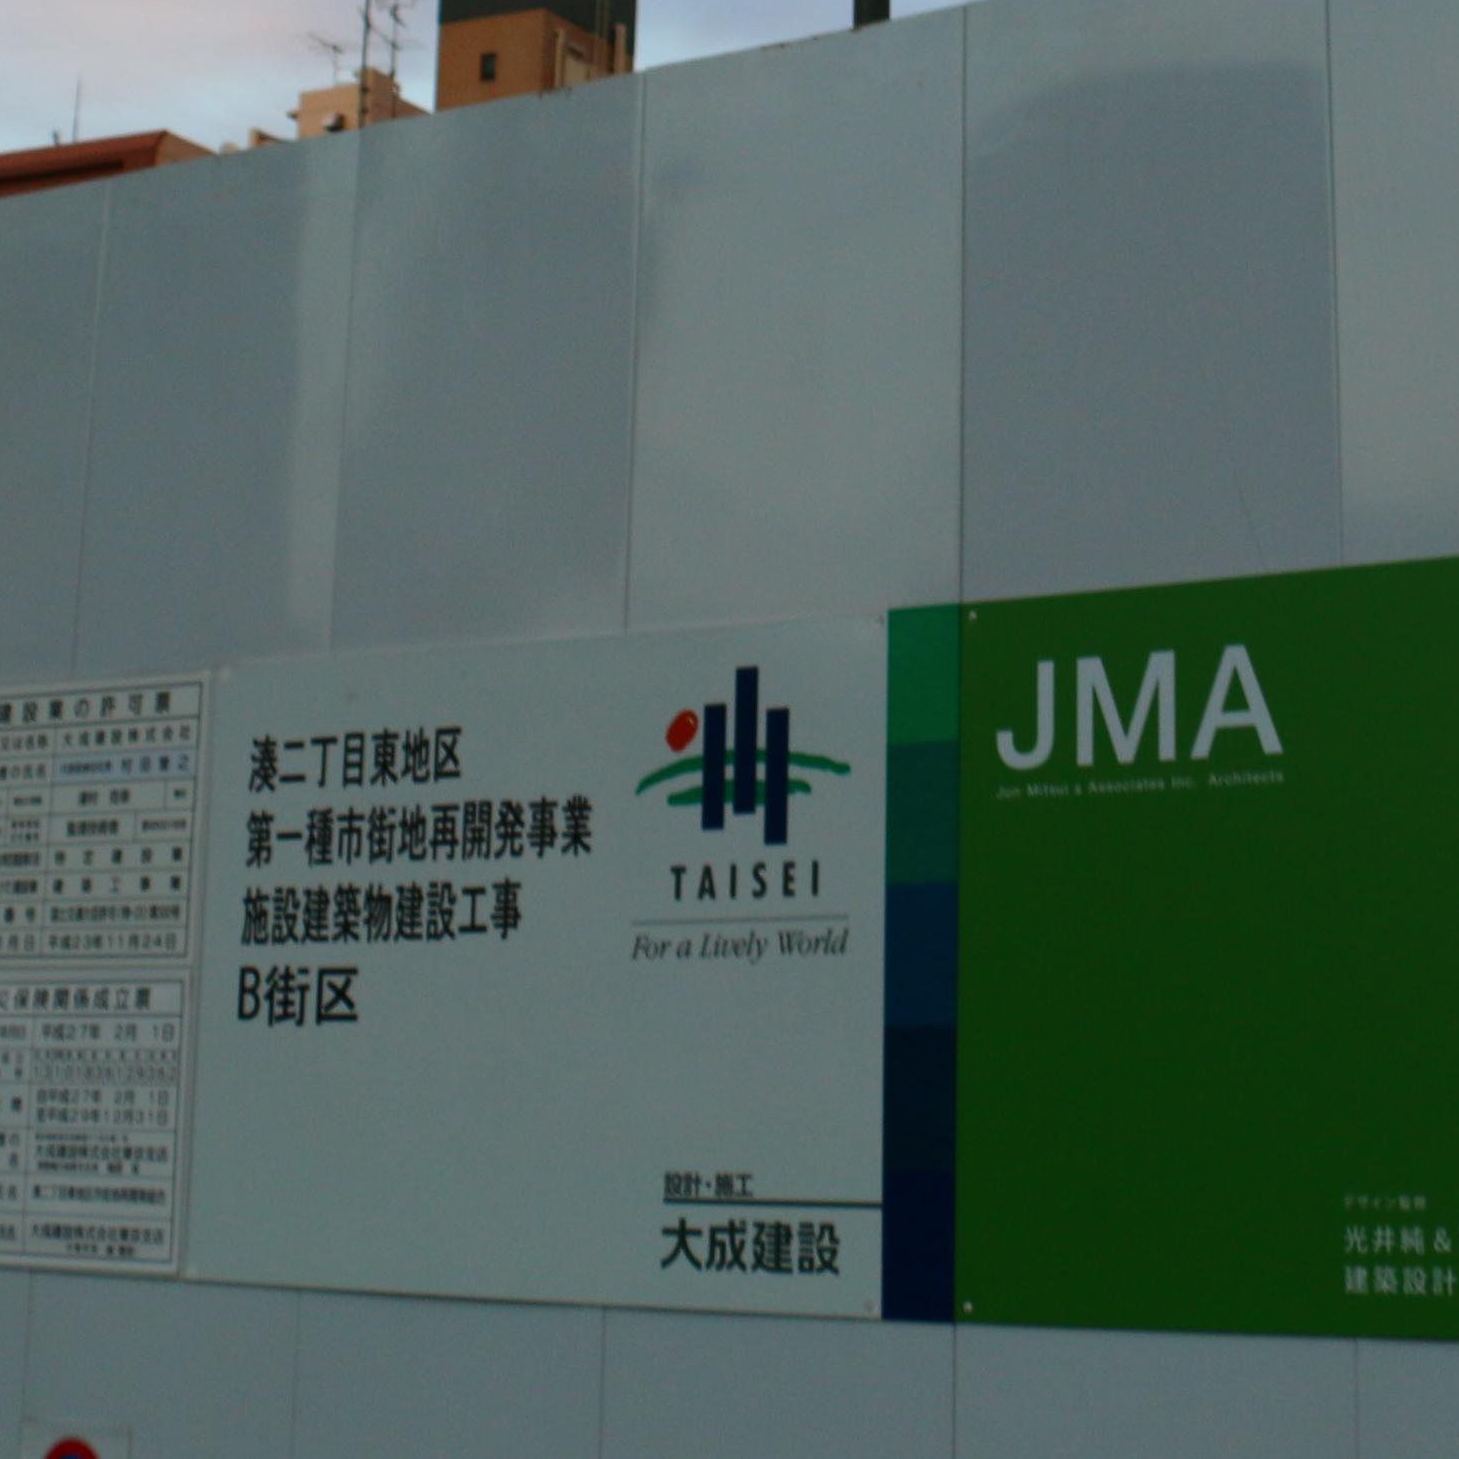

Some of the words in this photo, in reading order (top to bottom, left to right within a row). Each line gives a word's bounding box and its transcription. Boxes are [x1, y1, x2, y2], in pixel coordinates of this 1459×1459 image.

[996, 644, 1284, 771] JMA
[248, 726, 462, 793] 湊二丁目東地区
[1208, 770, 1285, 787] Architects
[245, 794, 593, 869] 第一種市街地再開発事業
[671, 860, 820, 901] TAISEI
[241, 878, 522, 946] 施設建築物建設工事
[631, 935, 671, 961] For
[675, 941, 691, 959] a
[699, 931, 767, 965] Lively
[777, 929, 848, 956] World
[237, 965, 359, 1026] B街区
[663, 1172, 754, 1198] 設計・施工
[660, 1217, 840, 1275] 大成建設
